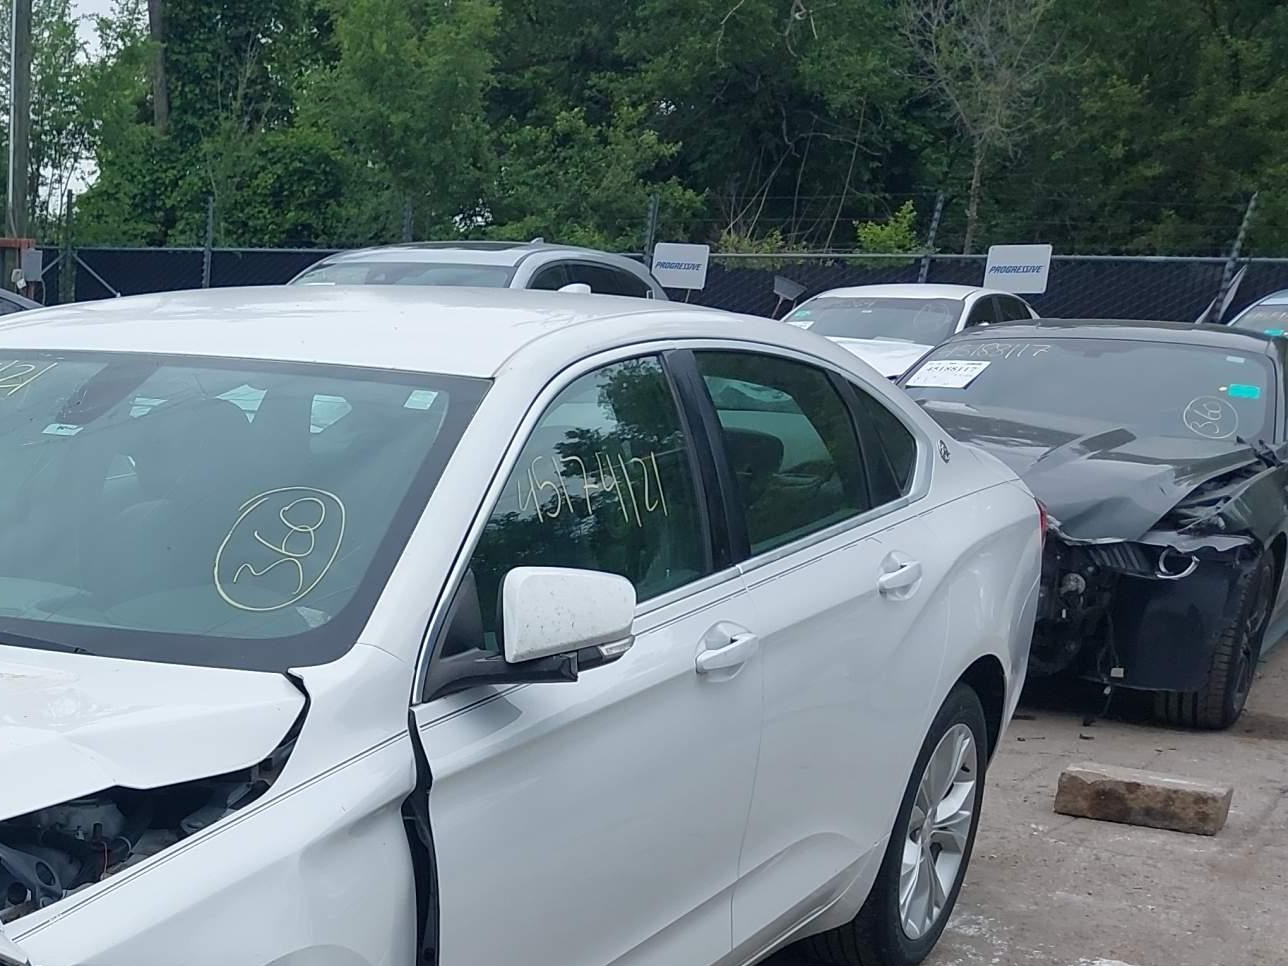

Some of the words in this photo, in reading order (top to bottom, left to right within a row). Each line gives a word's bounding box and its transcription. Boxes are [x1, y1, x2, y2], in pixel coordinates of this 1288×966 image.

[655, 261, 703, 271] PROGRESSIVE
[989, 265, 1045, 274] PROGRESSIVE
[517, 451, 669, 529] 45174121
[231, 495, 328, 596] 360
